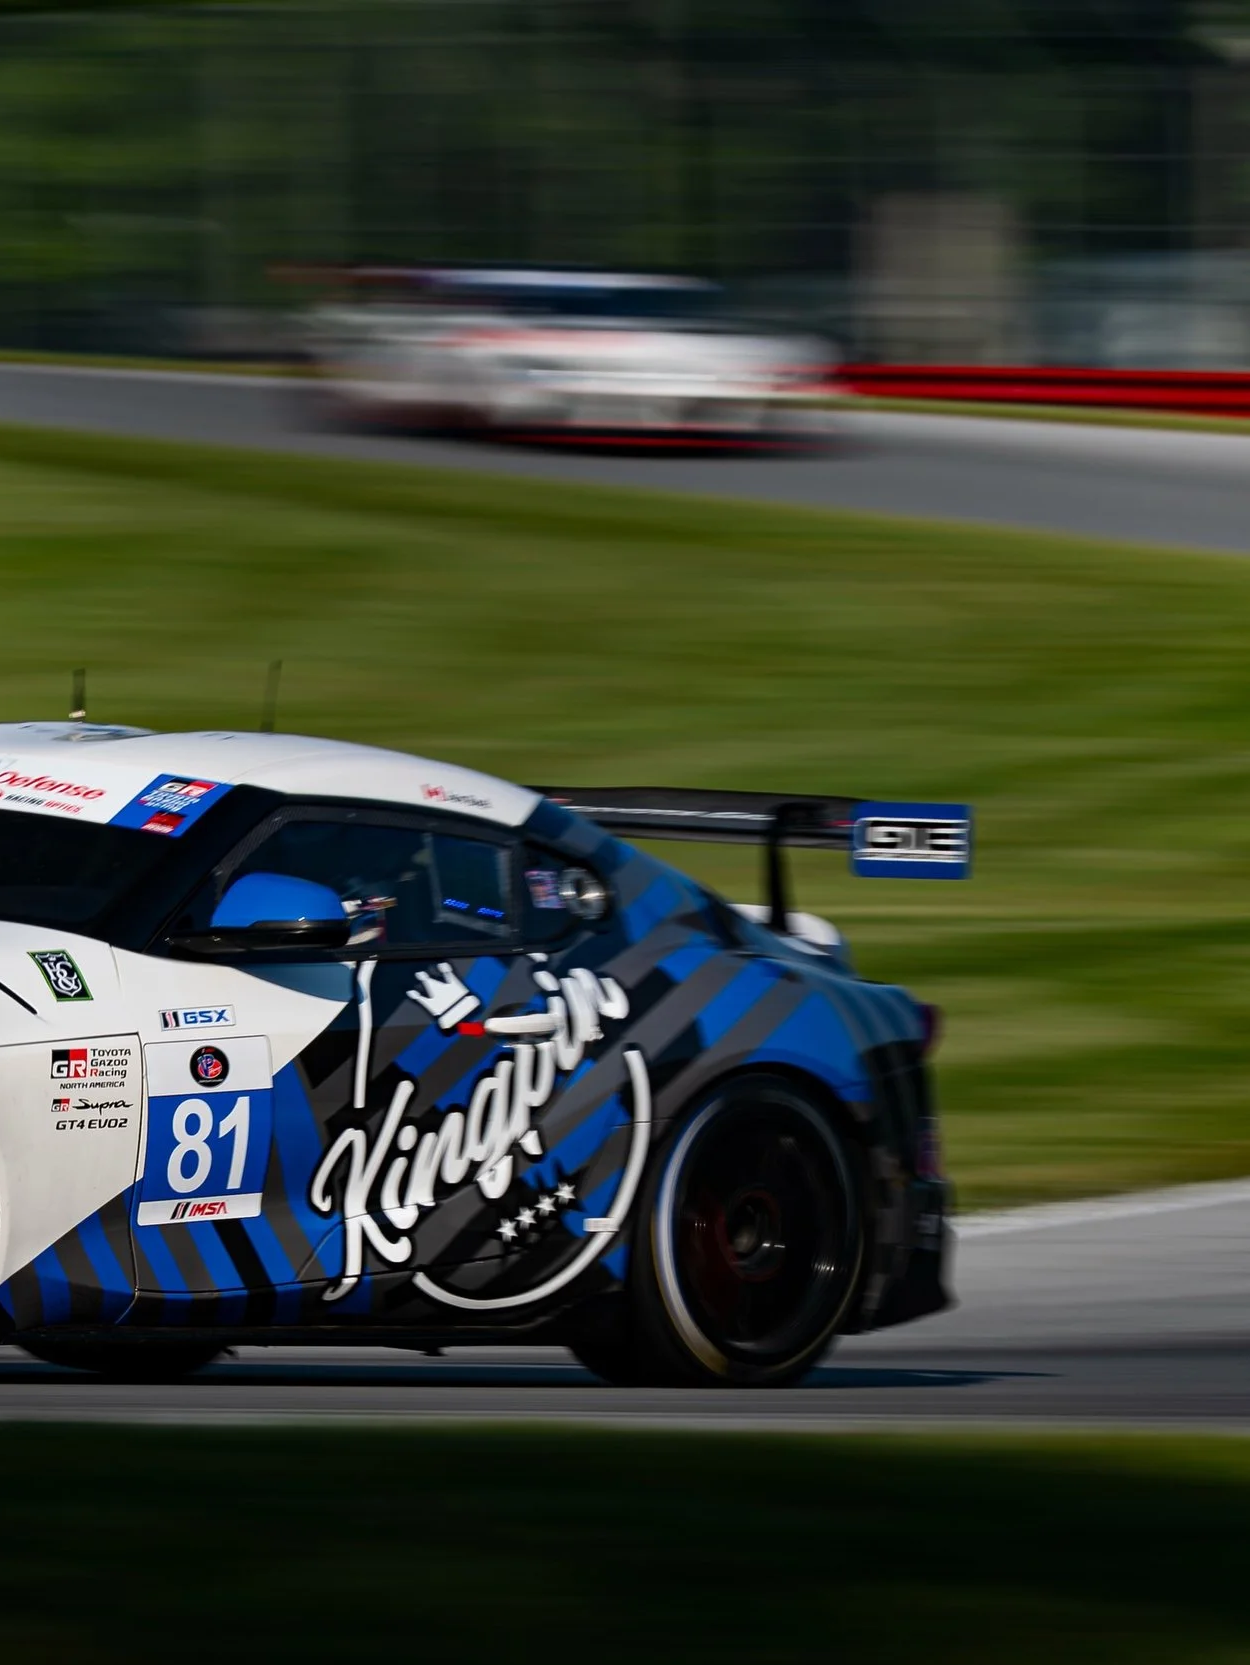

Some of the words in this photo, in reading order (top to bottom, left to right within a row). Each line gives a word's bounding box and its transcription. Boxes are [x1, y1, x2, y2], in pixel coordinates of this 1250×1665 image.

[4, 794, 45, 806] RACING
[183, 1009, 230, 1025] GSX
[90, 1048, 132, 1058] TOYOTA
[51, 1057, 87, 1078] GR
[90, 1058, 128, 1067] GAZOO
[90, 1067, 127, 1079] Racing
[59, 1082, 88, 1090] NORTH
[88, 1081, 125, 1089] AMERICA
[72, 1098, 134, 1116] Supra
[56, 1120, 86, 1131] GT4
[87, 1118, 129, 1130] EVO2
[311, 965, 630, 1301] Kingpin
[167, 1096, 250, 1194] 81
[188, 1201, 228, 1217] IMSA
